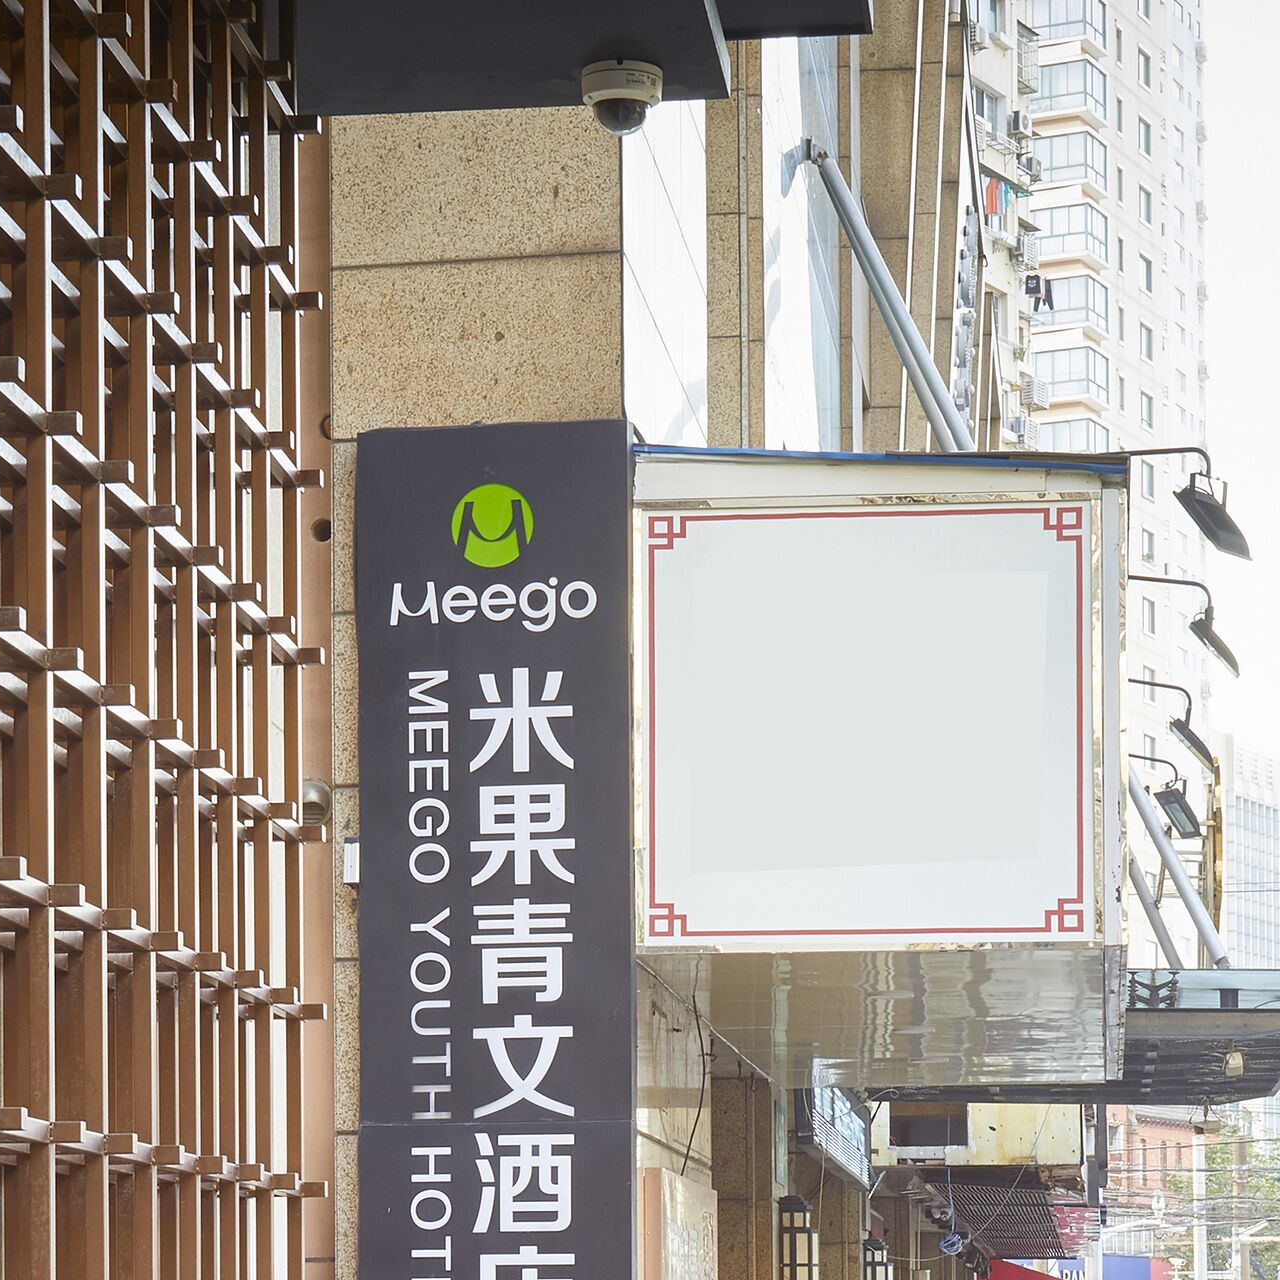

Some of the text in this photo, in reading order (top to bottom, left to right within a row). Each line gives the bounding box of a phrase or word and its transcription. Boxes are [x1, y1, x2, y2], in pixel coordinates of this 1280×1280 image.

[390, 576, 597, 632] Meego
[408, 670, 450, 884] MEEGO
[410, 906, 451, 1120] YOUTH
